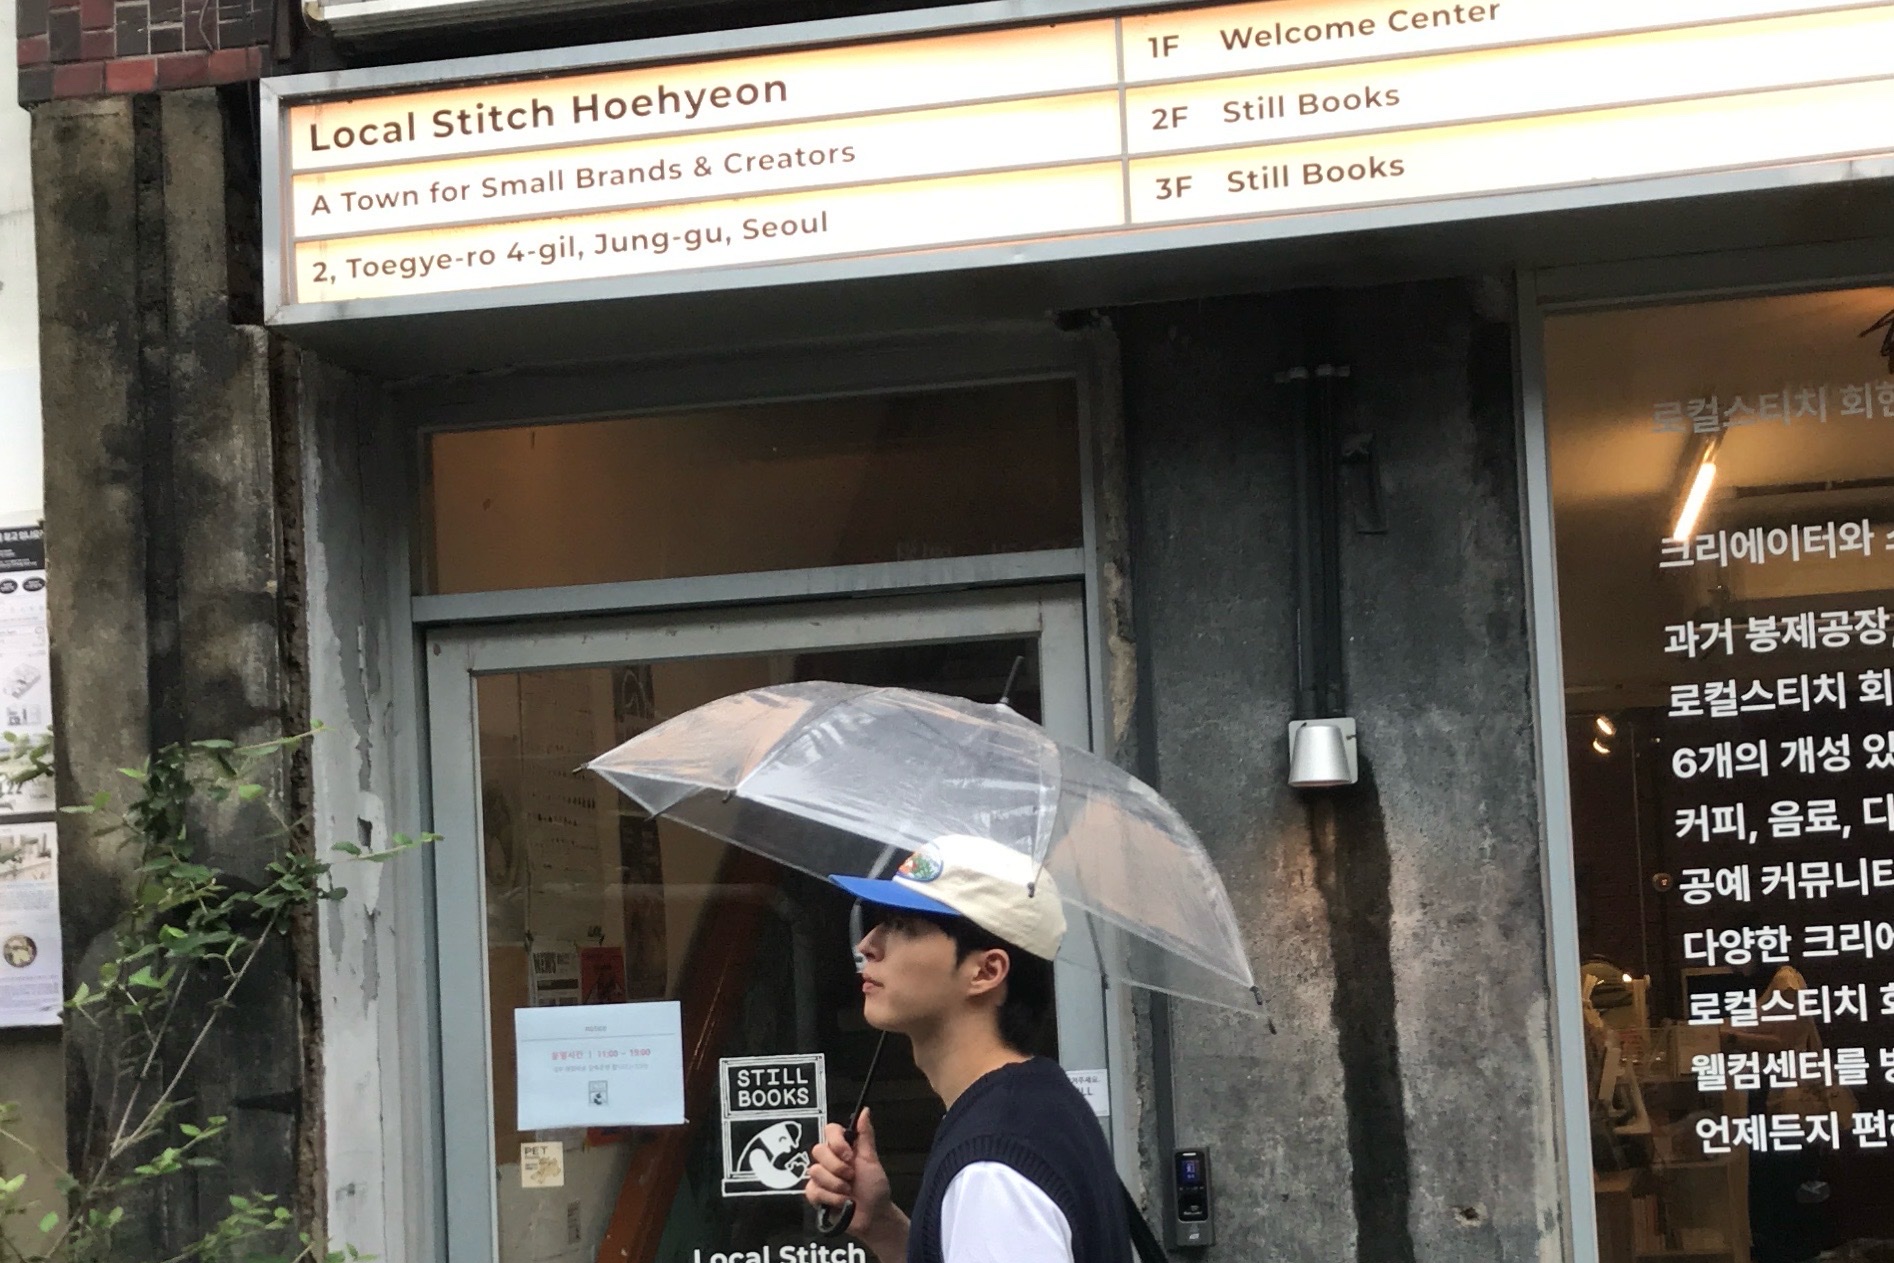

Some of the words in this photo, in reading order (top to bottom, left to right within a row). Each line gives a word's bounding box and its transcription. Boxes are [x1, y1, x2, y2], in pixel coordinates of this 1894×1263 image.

[1149, 34, 1179, 59] 1F
[1220, 18, 1376, 51] Welcome
[1388, 1, 1497, 33] Center
[310, 111, 416, 152] Local
[433, 98, 555, 139] Stitch
[573, 76, 788, 124] Hoehyeon
[1153, 105, 1188, 131] 2F
[1223, 96, 1285, 124] Still
[1299, 86, 1400, 116] Books
[312, 194, 331, 215] A
[345, 189, 419, 212] Town
[430, 181, 468, 203] for
[482, 170, 564, 199] Small
[577, 160, 683, 190] Brands
[694, 160, 712, 178] &
[724, 148, 855, 174] Creators
[1156, 175, 1191, 200] 3F
[1227, 165, 1289, 193] Still
[1303, 155, 1405, 186] Books
[313, 262, 336, 283] 2,
[347, 249, 496, 280] Toegye-ro
[507, 236, 584, 266] 4-gil,
[595, 227, 731, 255] Jung-gu,
[743, 211, 828, 240] Seoul
[1652, 385, 1828, 434] 로컬스티치
[1659, 519, 1875, 569] 크리에이터와
[1664, 618, 1734, 658] 과거
[1744, 606, 1894, 654] 봉제공장
[1668, 671, 1847, 718] 로컬스티치
[1858, 668, 1894, 706] 회
[1672, 739, 1769, 780] 6개의
[1780, 733, 1851, 774] 개성
[1675, 802, 1758, 844] 커피,
[1768, 799, 1852, 839] 음료,
[1679, 864, 1751, 905] 공예
[1683, 924, 1792, 966] 다양한
[1688, 983, 1868, 1027] 로컬스티치
[737, 1066, 809, 1087] STILL
[1691, 1046, 1869, 1091] 웰컴센터를
[738, 1087, 810, 1107] BOOKS
[525, 1146, 548, 1155] PET
[1696, 1110, 1840, 1154] 언제든지
